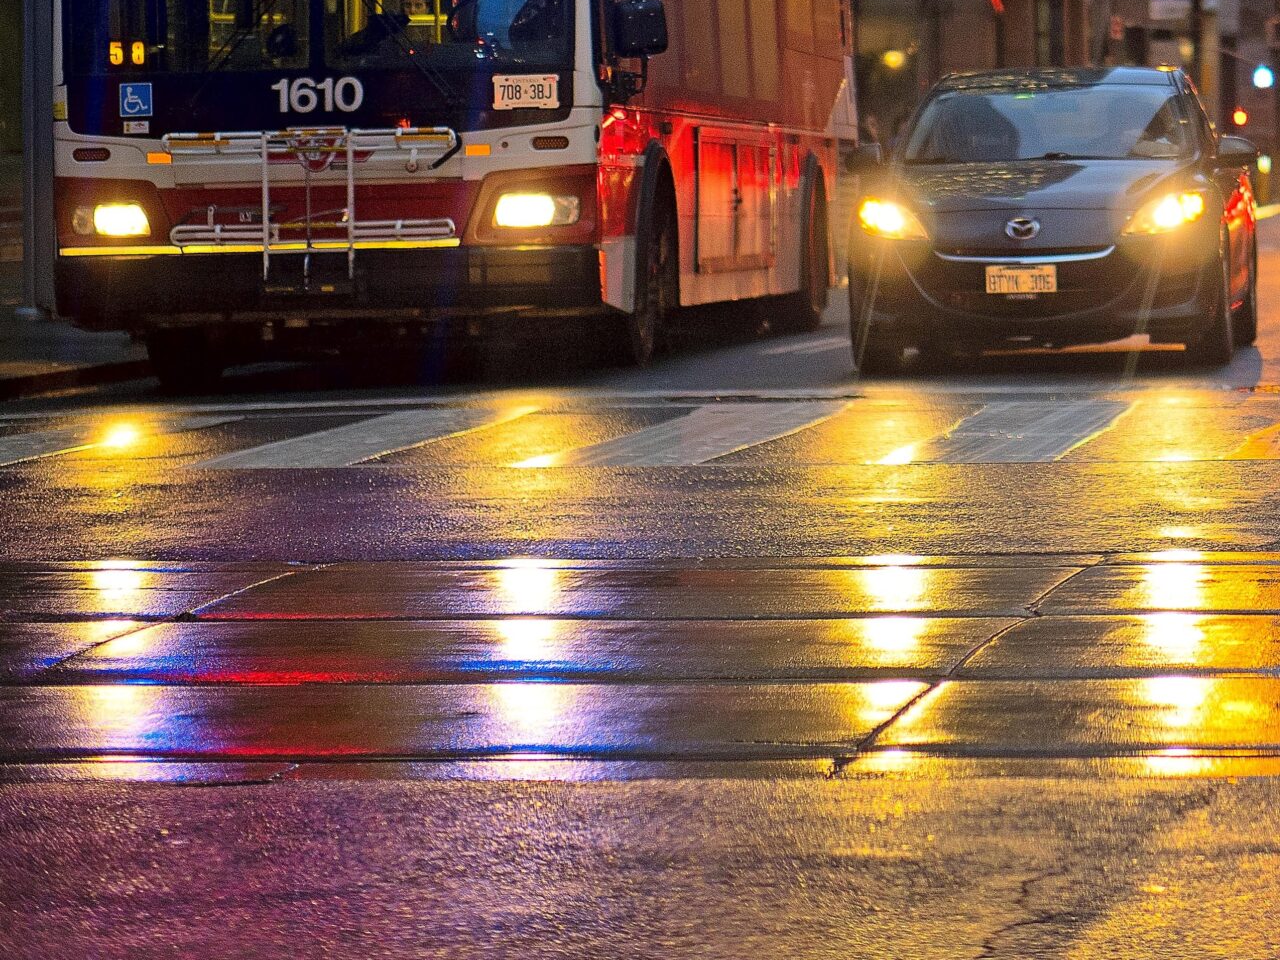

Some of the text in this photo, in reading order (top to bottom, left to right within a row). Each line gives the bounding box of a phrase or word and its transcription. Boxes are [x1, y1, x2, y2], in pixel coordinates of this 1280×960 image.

[271, 76, 364, 113] 1610
[500, 83, 552, 100] 708 3BJ
